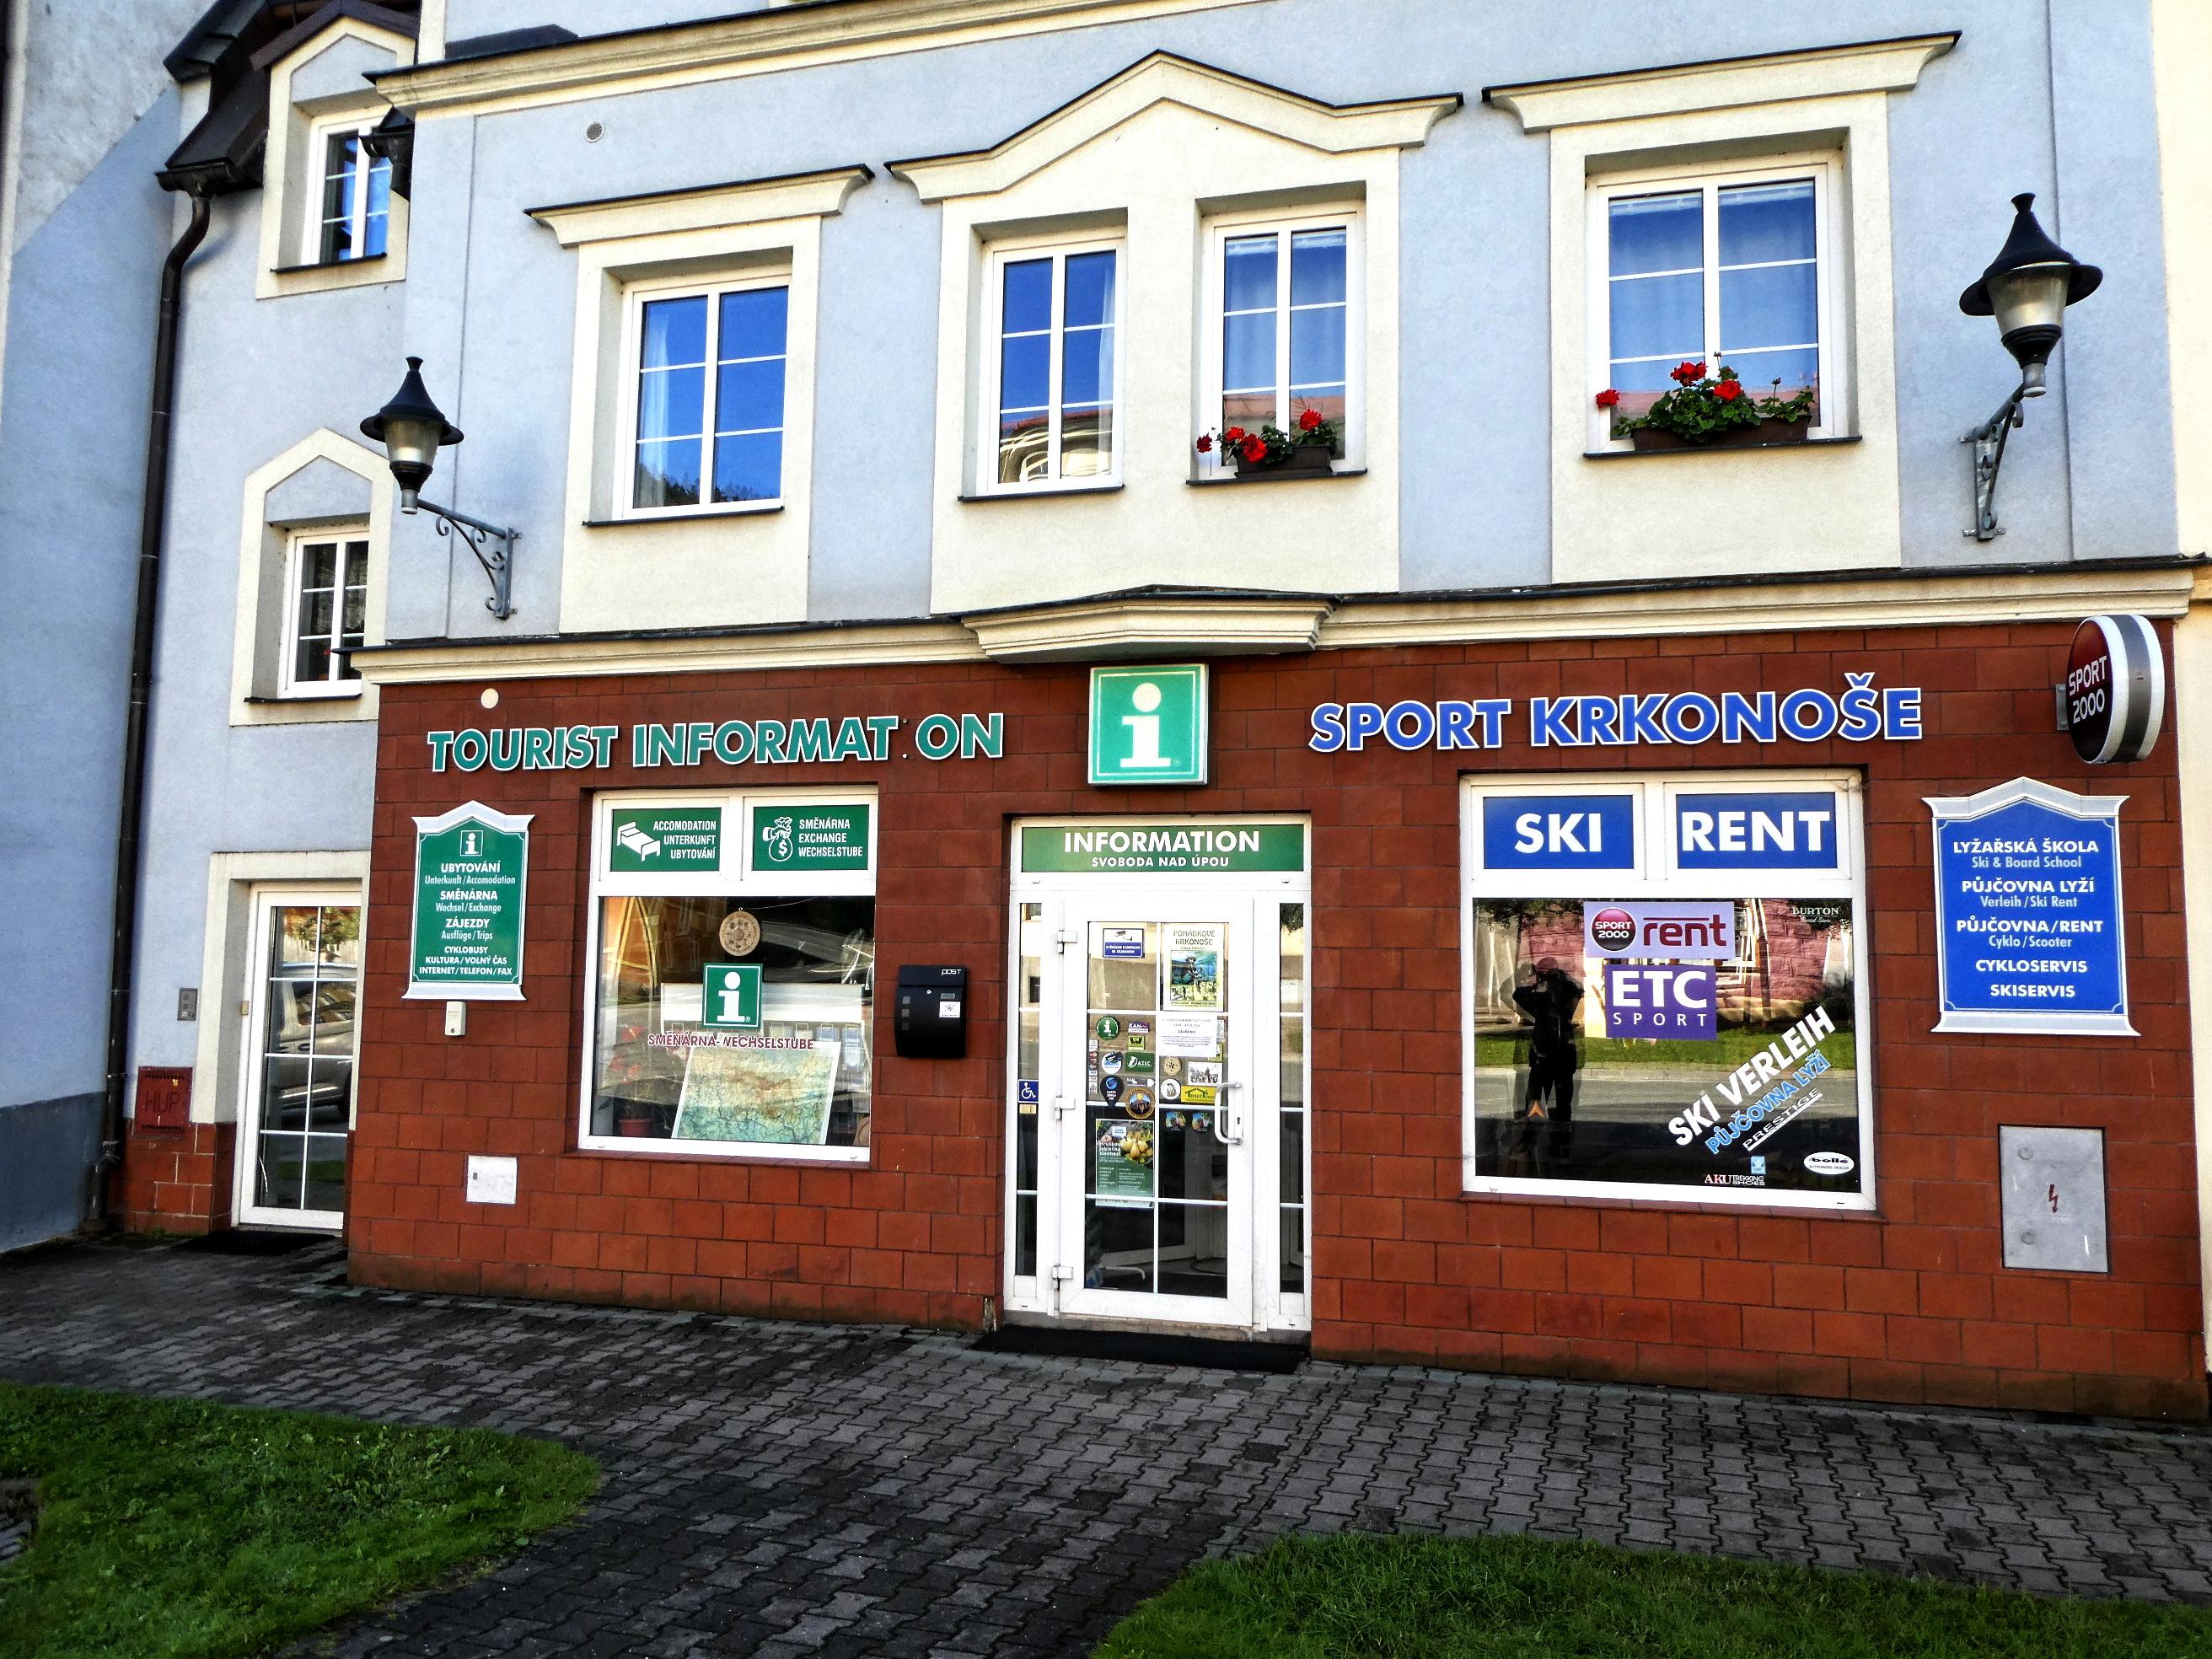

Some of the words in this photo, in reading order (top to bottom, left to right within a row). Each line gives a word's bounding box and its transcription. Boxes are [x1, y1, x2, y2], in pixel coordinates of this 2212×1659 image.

[2068, 655, 2107, 696] SPORT
[1307, 698, 1511, 752] SPORT
[1530, 671, 1923, 747] KRKONOŠE
[2072, 689, 2105, 724] 2000
[427, 725, 618, 772] TOURIST
[652, 820, 717, 831] ACCOMODATION
[799, 816, 851, 830] SMĚNÁRNA
[798, 832, 847, 843] EXCHANGE
[1514, 813, 1601, 853] SKI
[1682, 811, 1831, 852] RENT
[663, 835, 717, 846] UNTERKUNFT
[1065, 830, 1259, 853] INFORMATION
[1953, 837, 2038, 853] LYŽAŘSKÁ
[2042, 837, 2099, 853] ŠKOLA
[670, 847, 716, 859] UBYTOVÁNÍ
[798, 846, 863, 858] WECHSELSTUBE
[441, 861, 501, 872] UBYTOVÁNÍ
[1092, 856, 1154, 867] SVOBODA
[1159, 856, 1187, 867] NAD
[1192, 854, 1229, 867] ÚPOU
[1972, 856, 1989, 867] Ski
[1992, 857, 2002, 867] &
[2005, 856, 2040, 867] Board
[2043, 856, 2081, 867] School
[1962, 876, 2054, 893] PŮJČOVNA
[2059, 877, 2095, 892] LYŽÍ
[440, 889, 498, 900] SMĚNÁRNA
[2051, 895, 2077, 907] Rent
[1792, 906, 1839, 915] BURTON
[445, 915, 490, 928] ZÁJEZDY
[1595, 921, 1632, 930] SPORT
[1598, 930, 1629, 938] 2000
[1643, 914, 1726, 946] rent
[492, 953, 507, 964] ČAS
[1975, 959, 2087, 973] CYKLOSERVIS
[1612, 970, 1707, 1008] ETC
[1990, 984, 2075, 997] SKISERVIS
[1613, 1012, 1707, 1026] SPORT
[1668, 1093, 1721, 1146] SKI
[1715, 1006, 1836, 1106] VERLEIH
[1705, 1081, 1799, 1155] PŮJČOVNA
[1793, 1049, 1831, 1087] LYŽÍ
[1742, 1087, 1821, 1150] PRESTIGE
[1705, 1173, 1731, 1184] AKU
